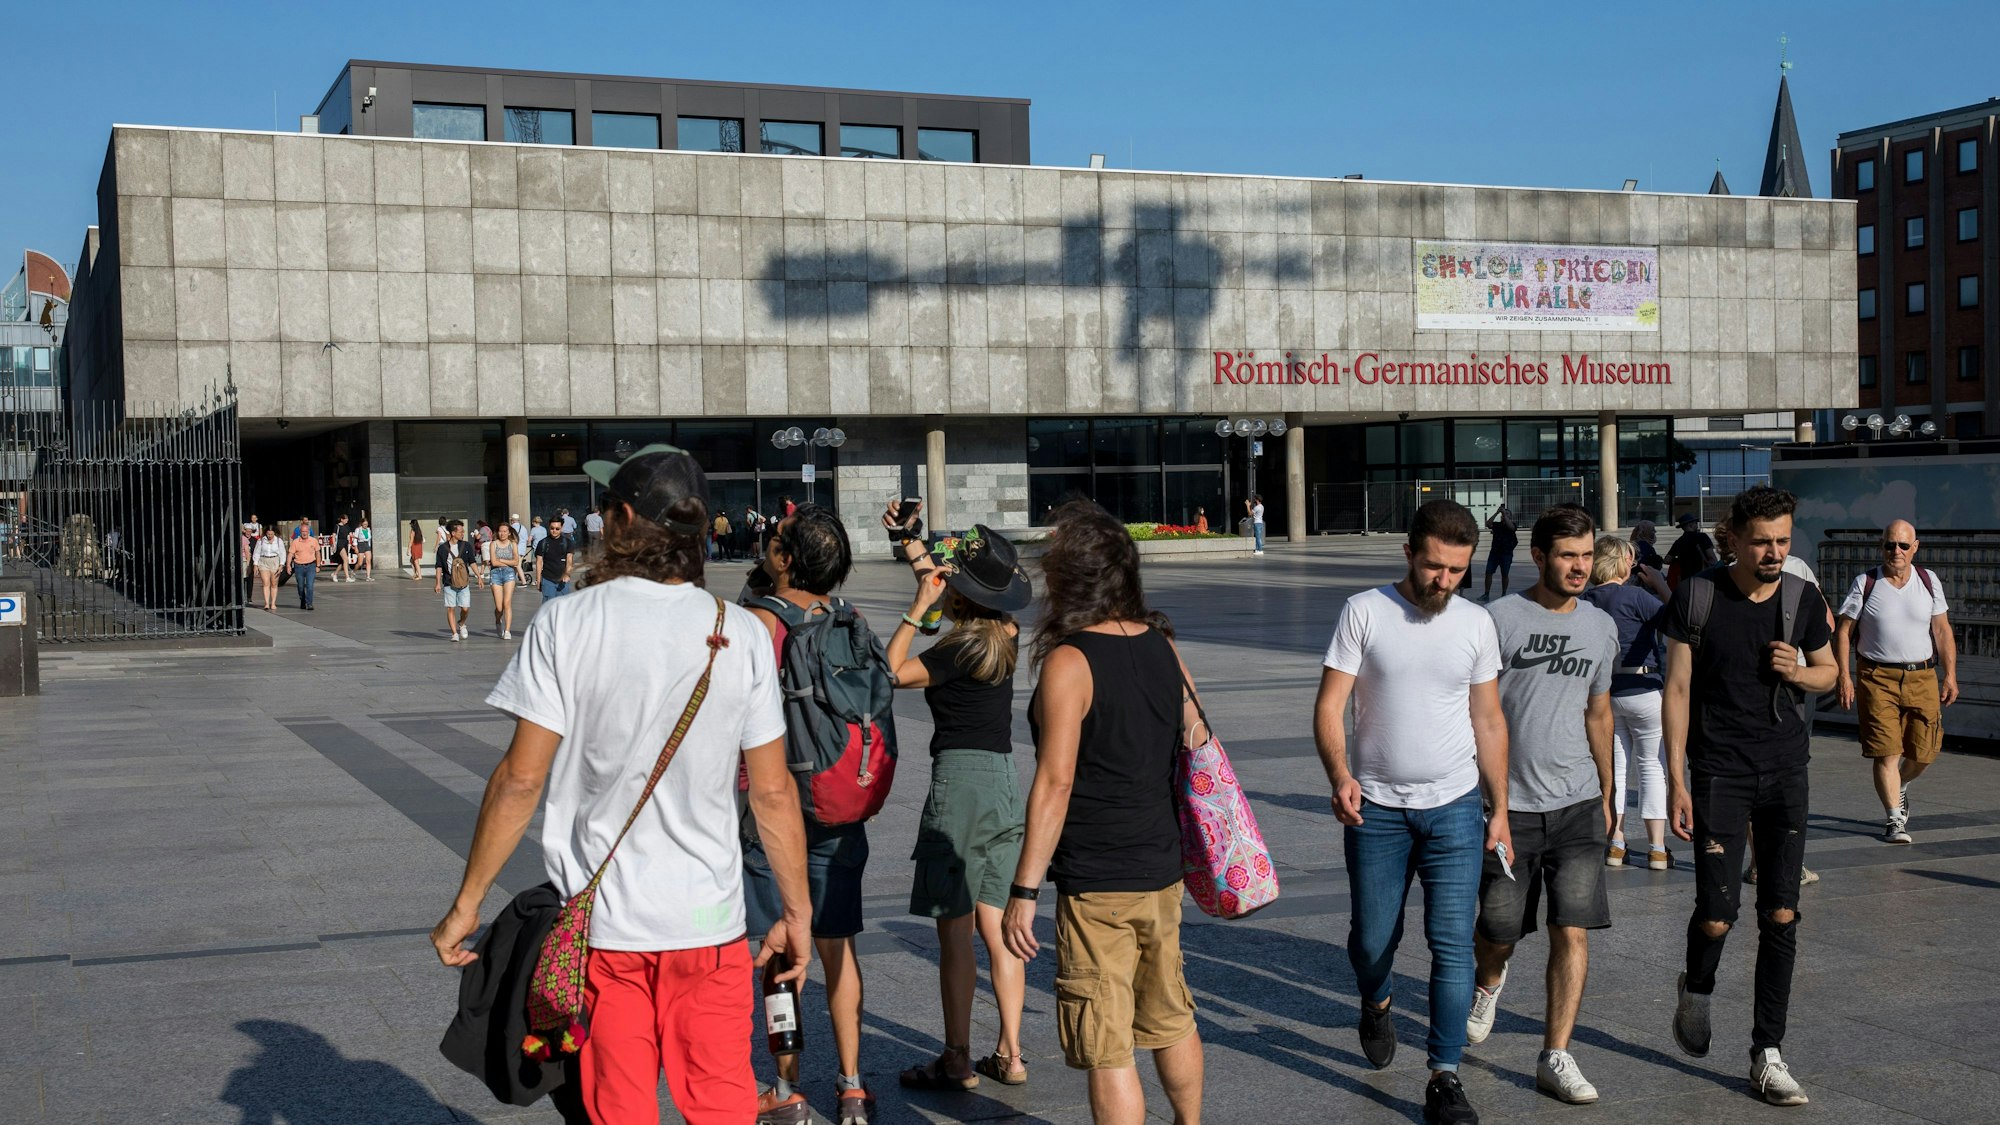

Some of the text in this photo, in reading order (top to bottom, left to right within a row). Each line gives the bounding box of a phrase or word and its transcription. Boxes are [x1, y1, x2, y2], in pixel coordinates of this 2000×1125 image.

[1213, 350, 1672, 385] Römisch-Germanisches Museum
[0, 599, 15, 620] P
[1523, 633, 1571, 654] JUST
